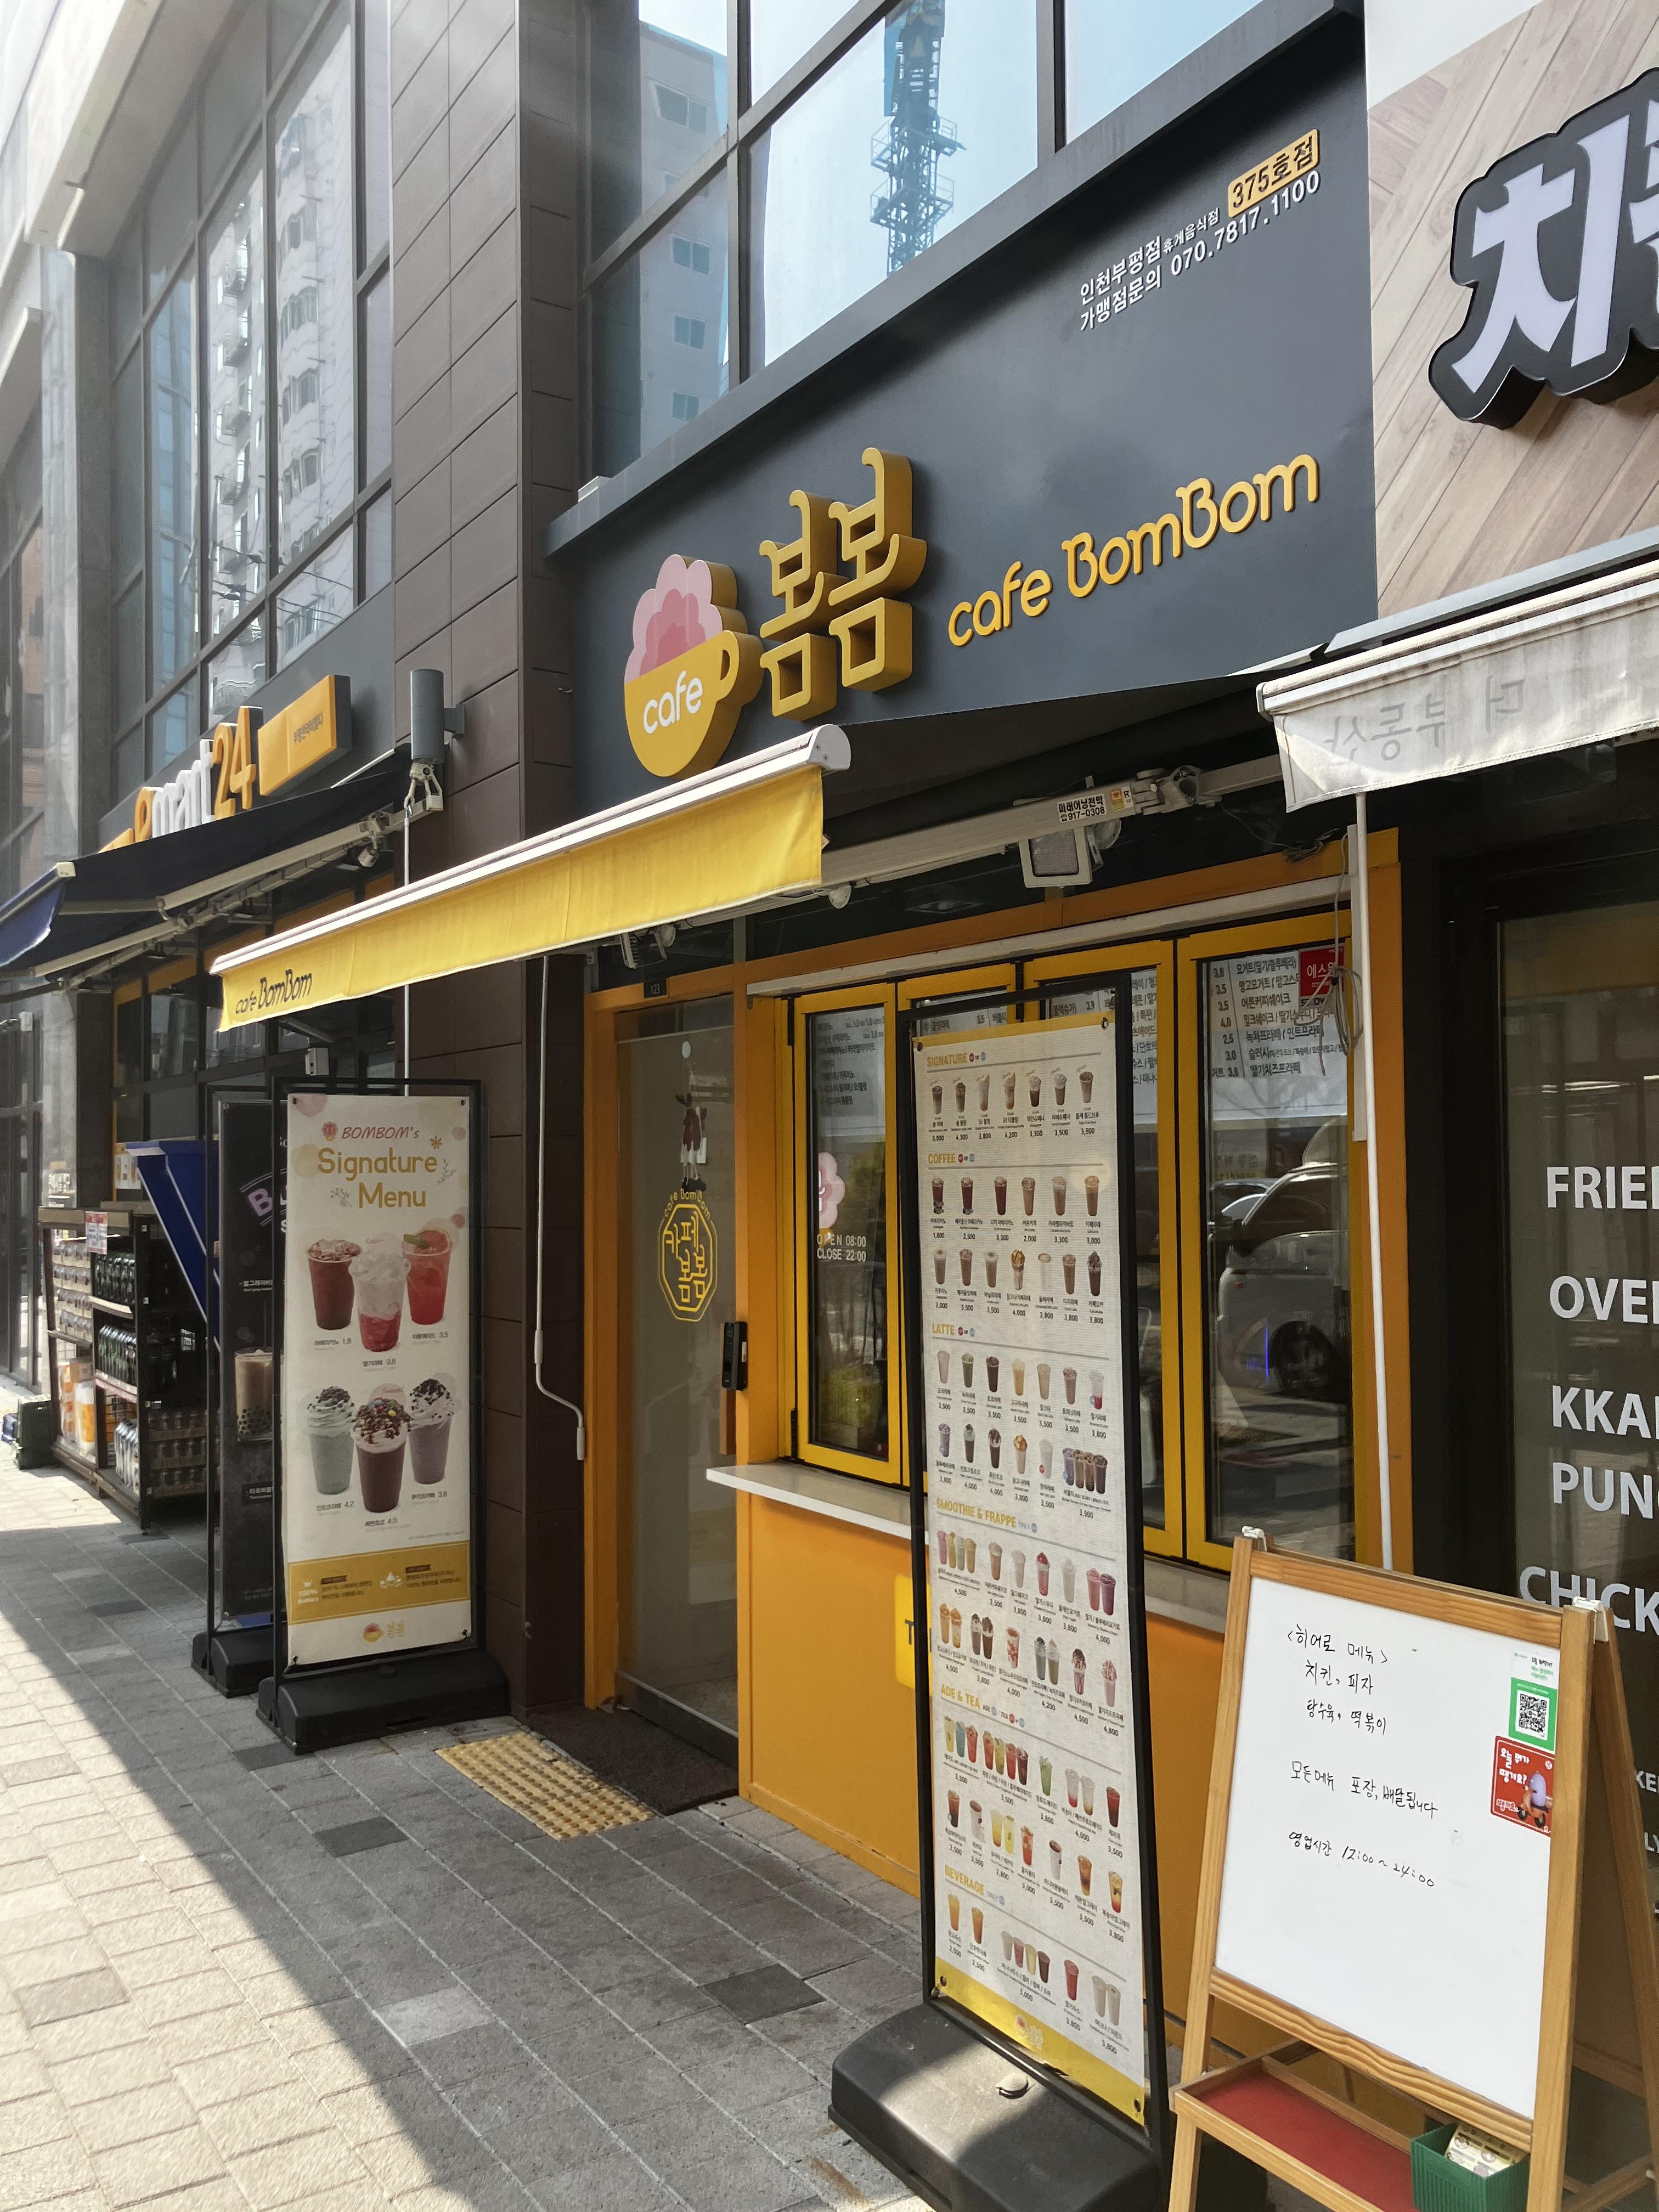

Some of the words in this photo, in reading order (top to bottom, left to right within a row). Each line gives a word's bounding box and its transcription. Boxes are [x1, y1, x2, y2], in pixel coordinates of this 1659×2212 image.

[1233, 136, 1313, 208] 375호점
[1080, 265, 1162, 331] 가맹점문의
[1171, 171, 1321, 275] 070.7817.1100
[1080, 236, 1161, 305] 인천부평점
[1163, 208, 1220, 253] 휴게음식점
[949, 561, 1052, 647] cafe
[1062, 454, 1319, 599] BomBom
[759, 448, 919, 720] 봄봄
[643, 670, 704, 735] cafe
[1059, 795, 1103, 813] 미래어닝천막
[235, 991, 257, 1014] cafe
[258, 969, 312, 1009] BomBom
[651, 984, 661, 995] 123
[927, 1053, 967, 1067] SIGNATURE
[342, 1126, 419, 1139] BOMBOM's
[318, 1147, 437, 1181] Signature
[928, 1154, 955, 1164] COFFEE
[359, 1182, 426, 1208] Menu
[1547, 1166, 1659, 1210] FRIE
[817, 1233, 842, 1245] OPEN
[846, 1235, 866, 1247] 08:00
[817, 1248, 842, 1260] CLOSE
[846, 1250, 866, 1262] 22:00
[1549, 1276, 1659, 1324] OVE
[933, 1323, 955, 1335] LATTE
[1552, 1385, 1659, 1440] KKA
[1553, 1462, 1659, 1520] PUN
[936, 1498, 975, 1515] SMOOTHIE
[977, 1509, 983, 1520] &
[985, 1509, 1016, 1528] FRAPPE
[941, 1684, 956, 1700] ADE
[958, 1693, 963, 1702] &
[965, 1694, 980, 1709] TEA
[1348, 1674, 1373, 1695] 피자
[1350, 1711, 1387, 1735] 떡볶이
[1289, 1831, 1332, 1857] 영업시간
[1341, 1846, 1374, 1864] 12:00
[1392, 1863, 1435, 1888] 24:00
[945, 1865, 984, 1895] BEVERAGE
